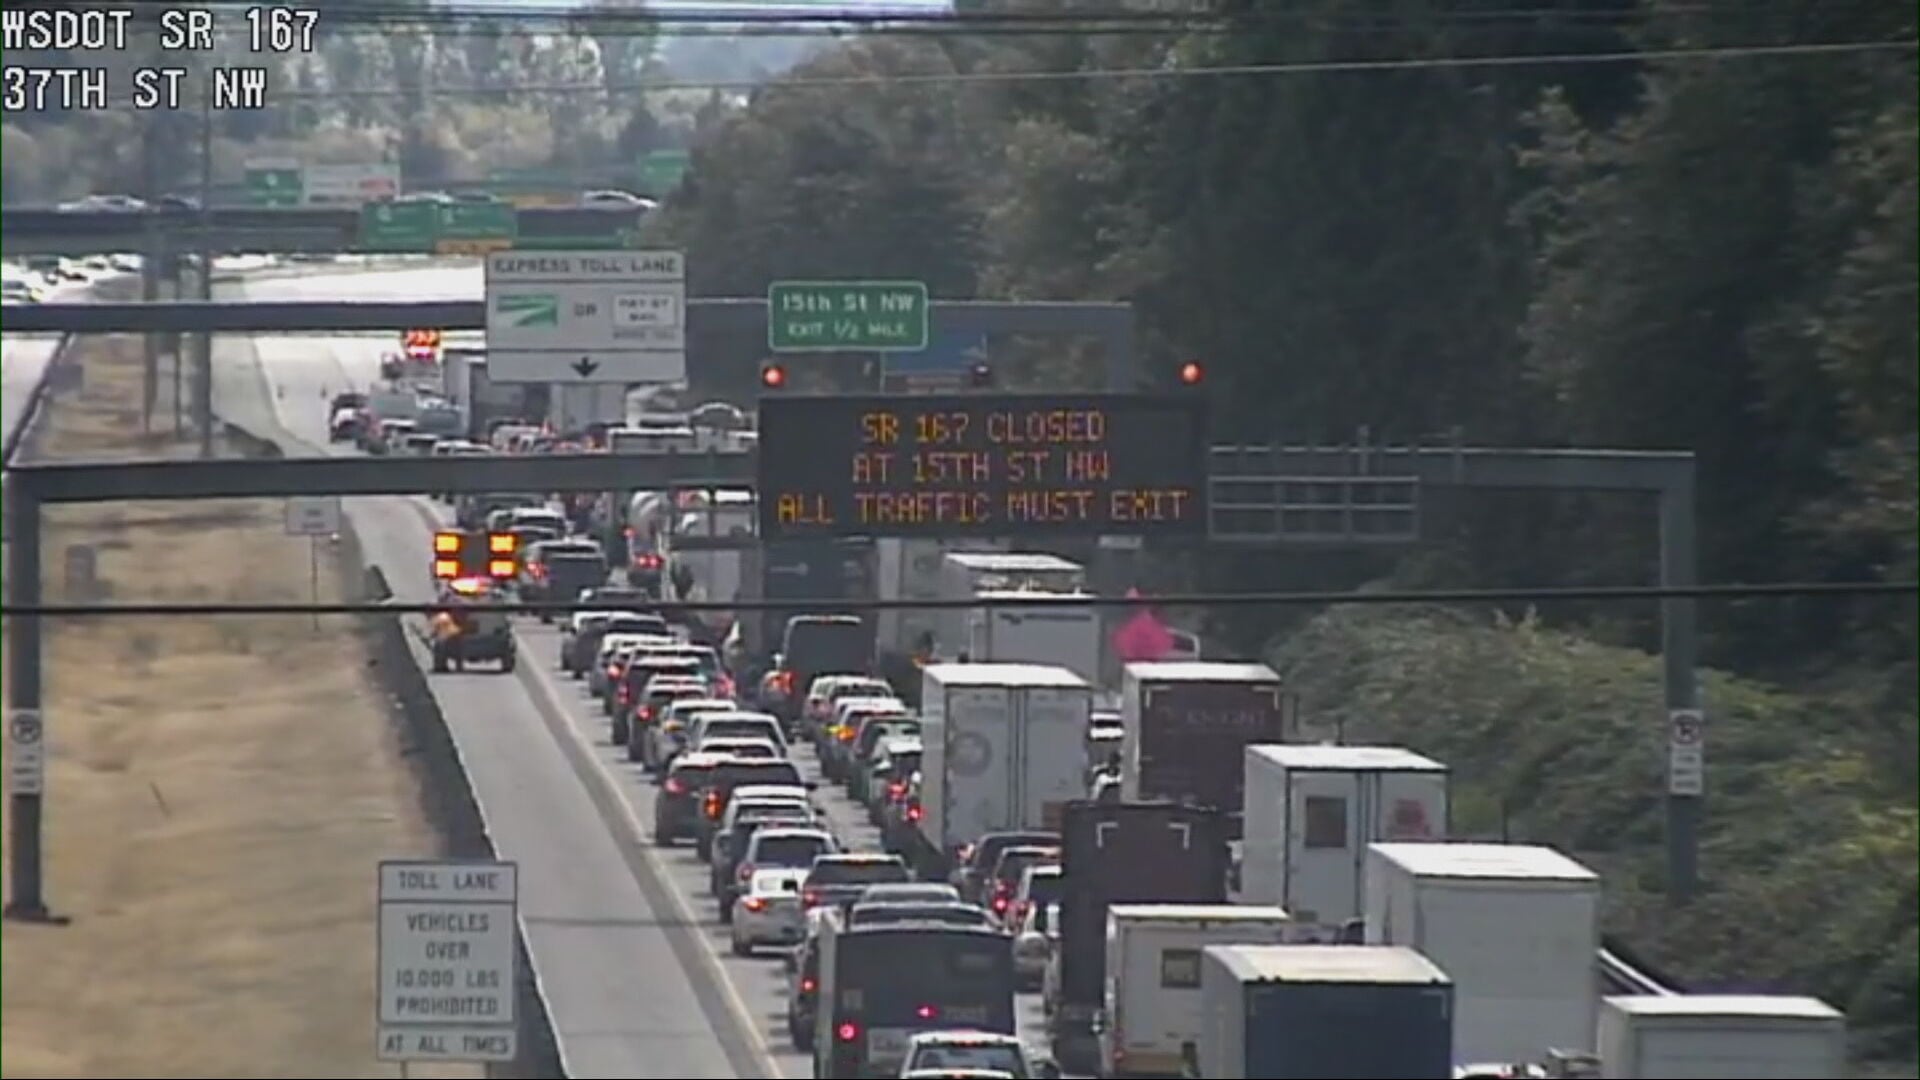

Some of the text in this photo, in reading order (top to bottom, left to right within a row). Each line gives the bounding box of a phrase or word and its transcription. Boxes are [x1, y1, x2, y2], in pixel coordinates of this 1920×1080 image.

[494, 258, 676, 273] EXPRESS TOLL LANE
[572, 303, 598, 317] OR
[782, 292, 915, 312] 15th St NW
[787, 319, 907, 340] EXIT 1/2 MILE
[861, 411, 1106, 444] SR 167 CLOSED
[852, 452, 1110, 484] AT 15TH ST NW
[777, 491, 1188, 525] ALL TRAFFIC MUST EXIT
[398, 872, 500, 890] TOLL LANE
[406, 914, 490, 933] VEHICLES
[425, 941, 470, 961] OVER
[465, 969, 500, 988] LBS
[395, 996, 498, 1016] PROHIBITED
[384, 1036, 510, 1054] AT ALL TIMES
